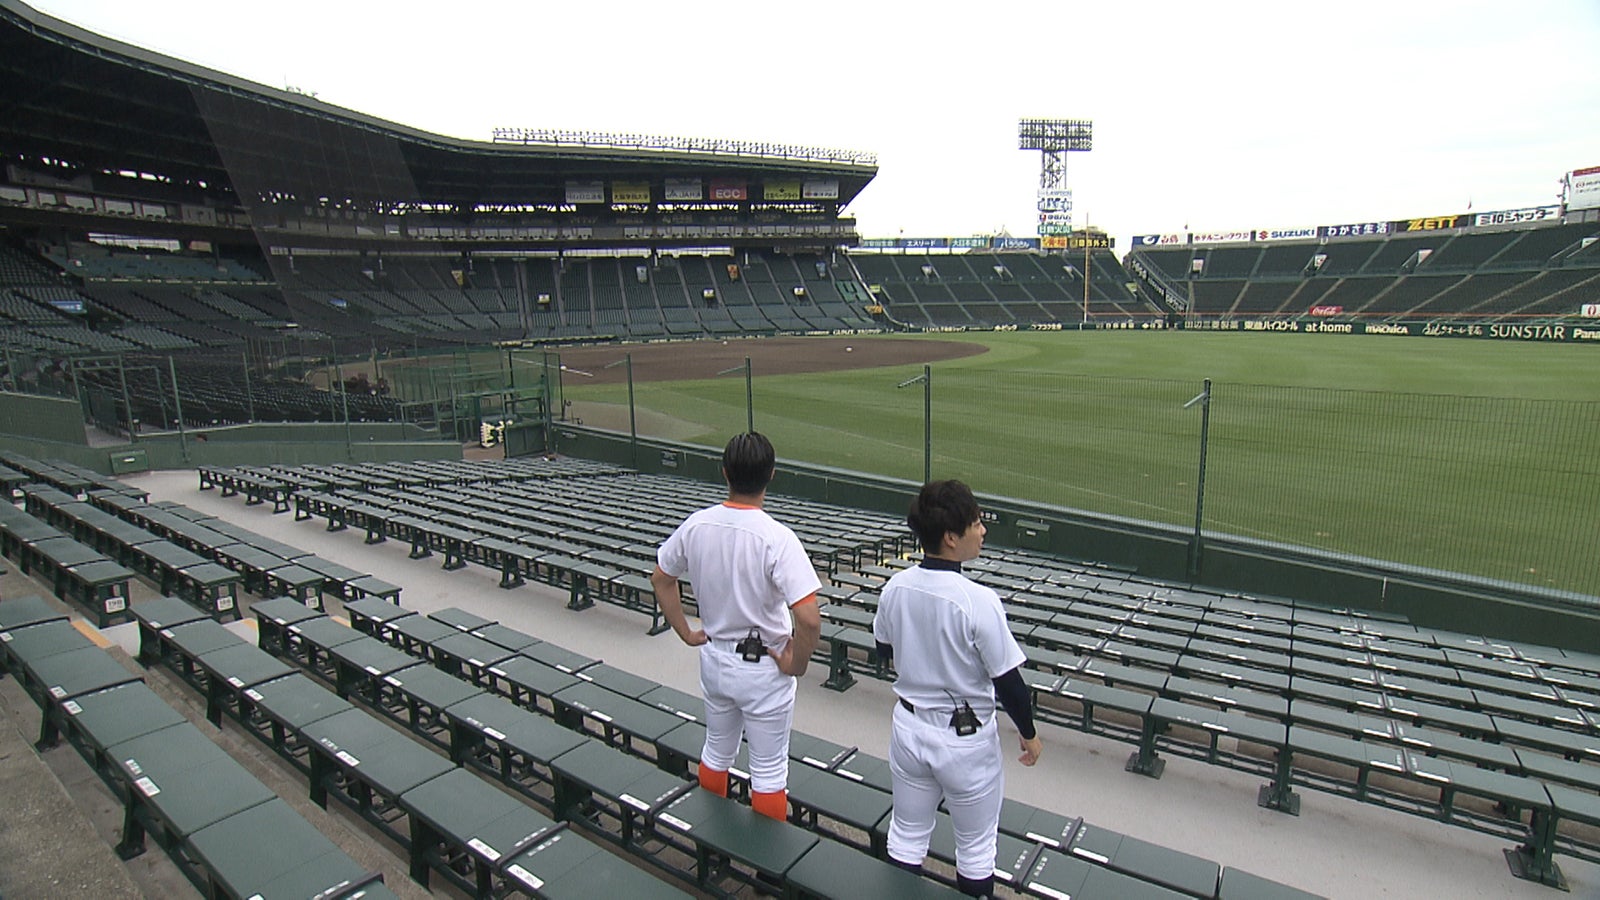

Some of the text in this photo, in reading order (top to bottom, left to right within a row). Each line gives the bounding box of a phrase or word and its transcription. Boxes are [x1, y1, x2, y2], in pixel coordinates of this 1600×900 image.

[716, 189, 740, 199] ECC
[1327, 221, 1388, 236] わかさ生活
[1407, 216, 1458, 231] ZETT
[1271, 229, 1315, 238] SUZUKI
[1305, 322, 1352, 333] at home
[1490, 325, 1564, 340] SUNSTAR
